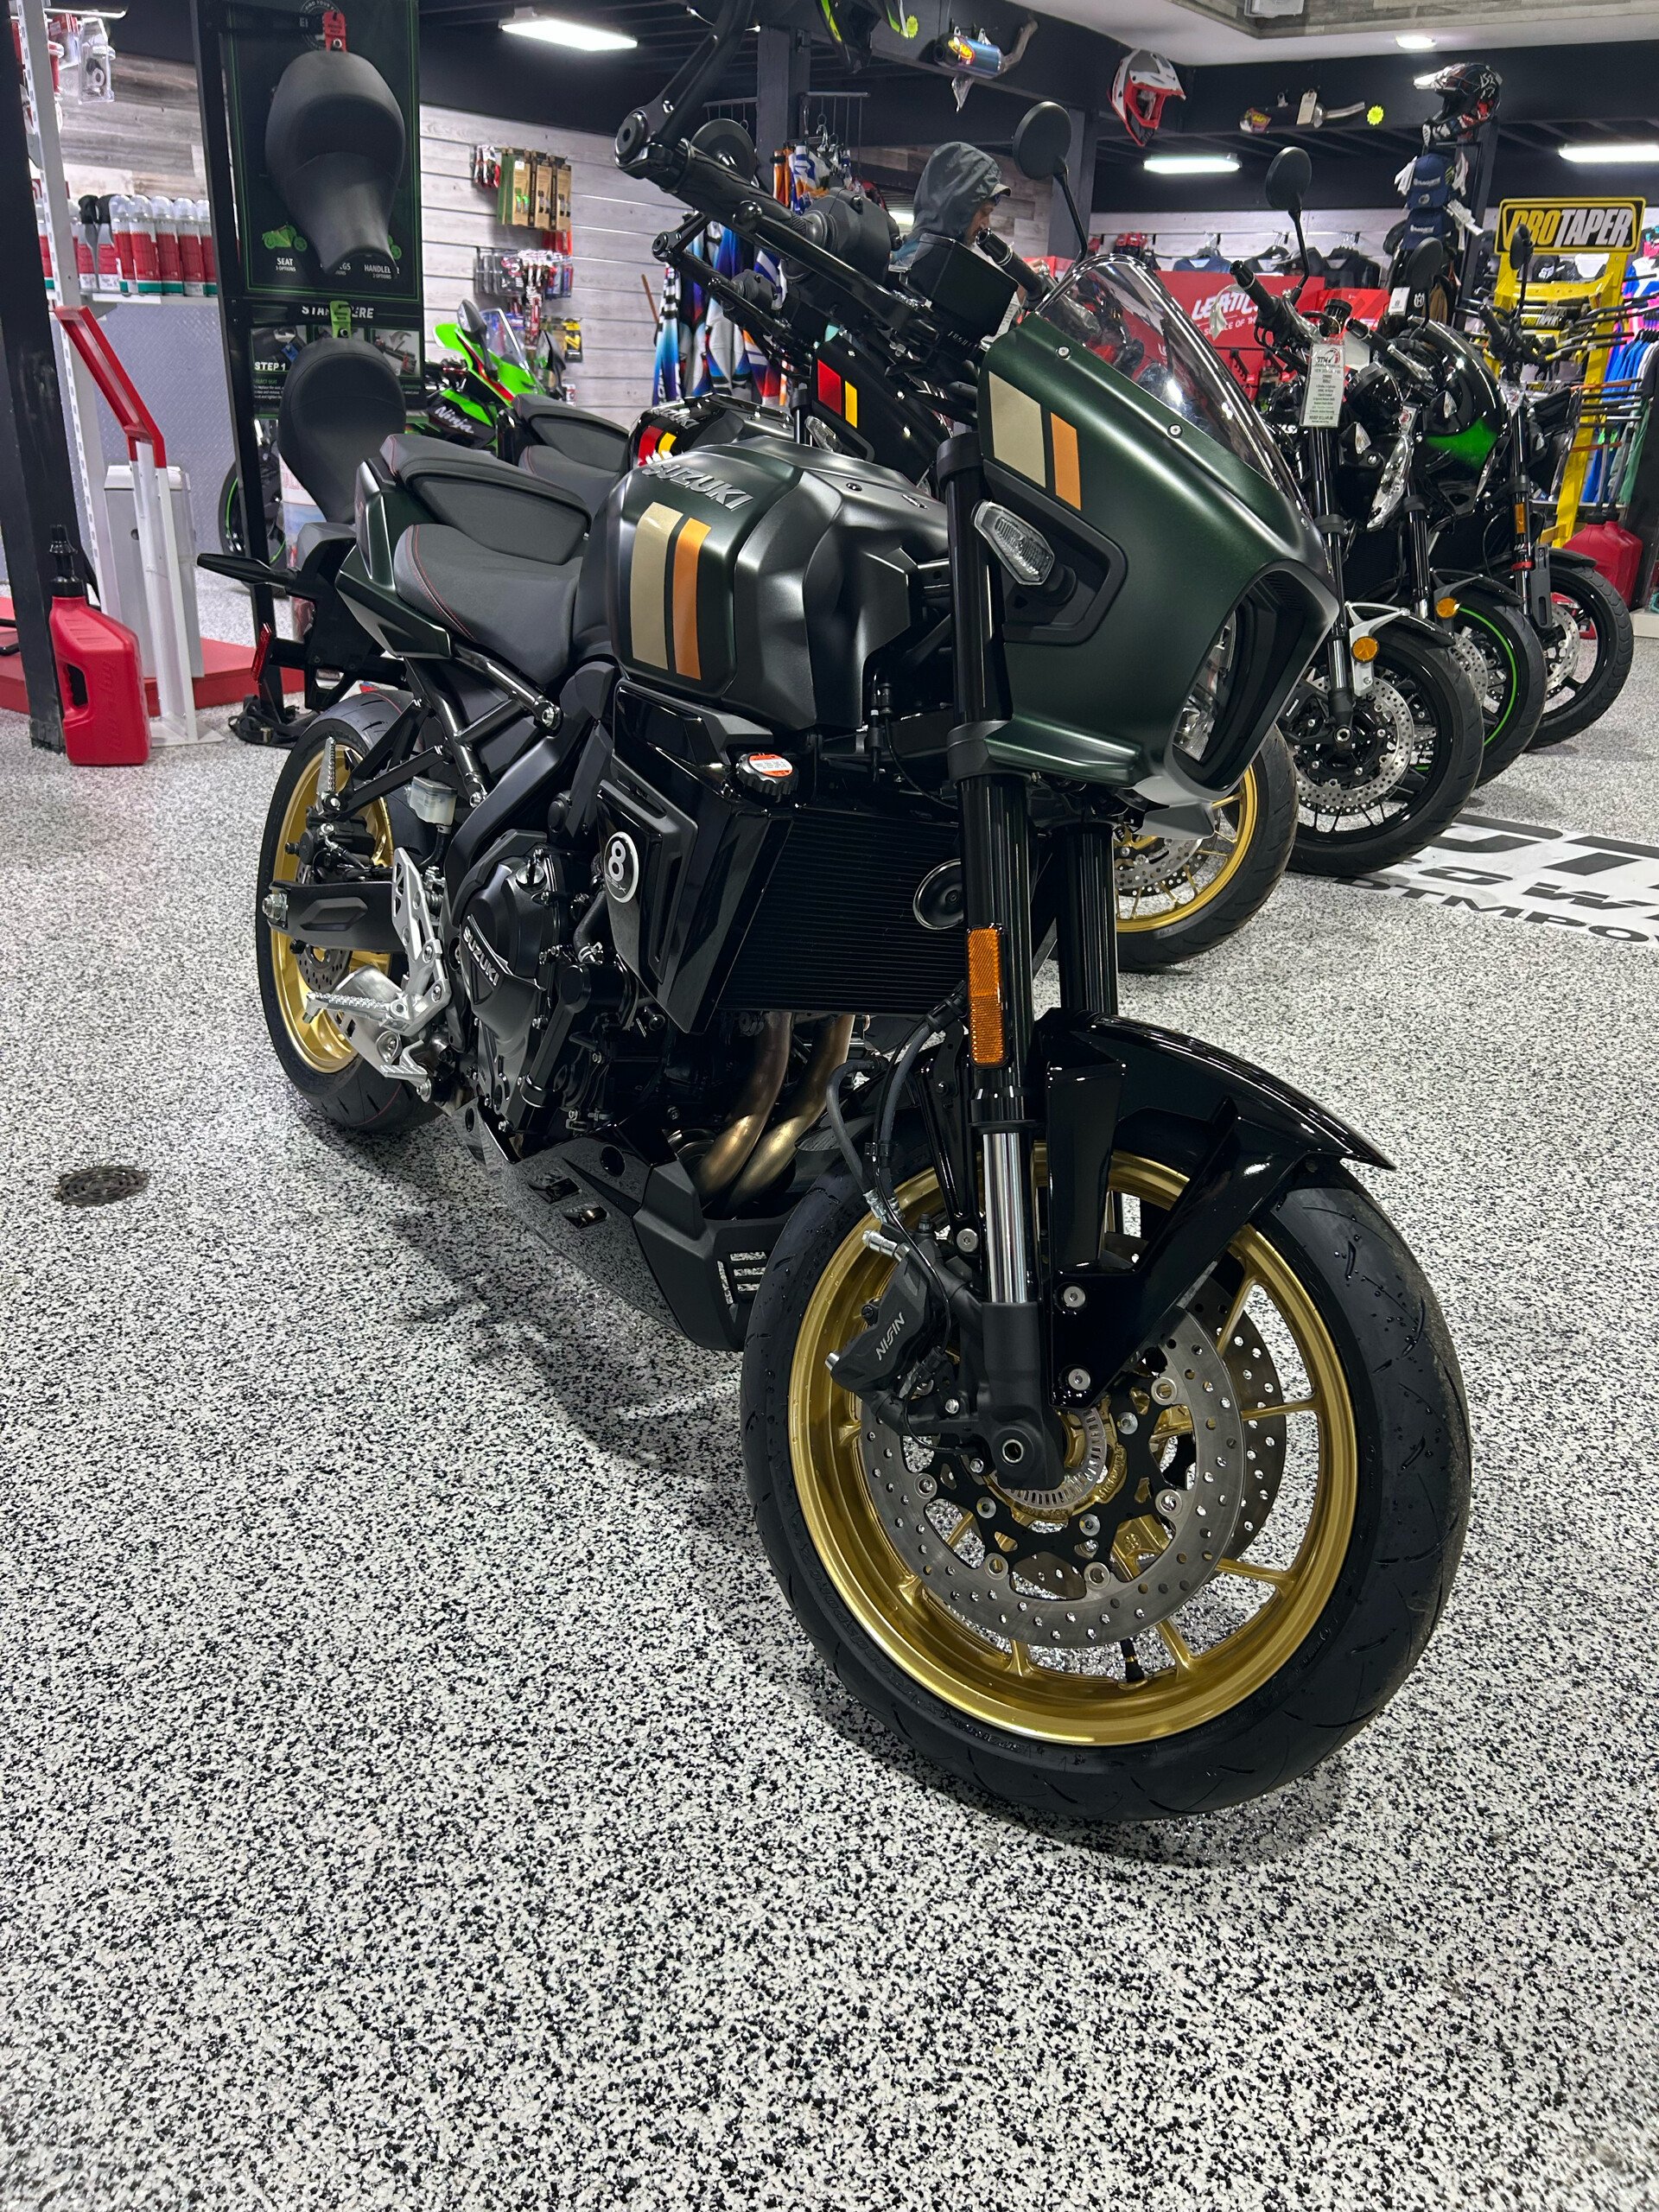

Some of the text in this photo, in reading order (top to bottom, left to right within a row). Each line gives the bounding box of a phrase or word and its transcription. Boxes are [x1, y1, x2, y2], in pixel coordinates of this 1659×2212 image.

[254, 361, 286, 372] STEP 1
[435, 405, 474, 434] Ninja
[641, 464, 753, 512] SUZUKI
[608, 840, 626, 882] 8
[463, 925, 500, 986] SUZUKI
[875, 1312, 905, 1361] NISSIN
